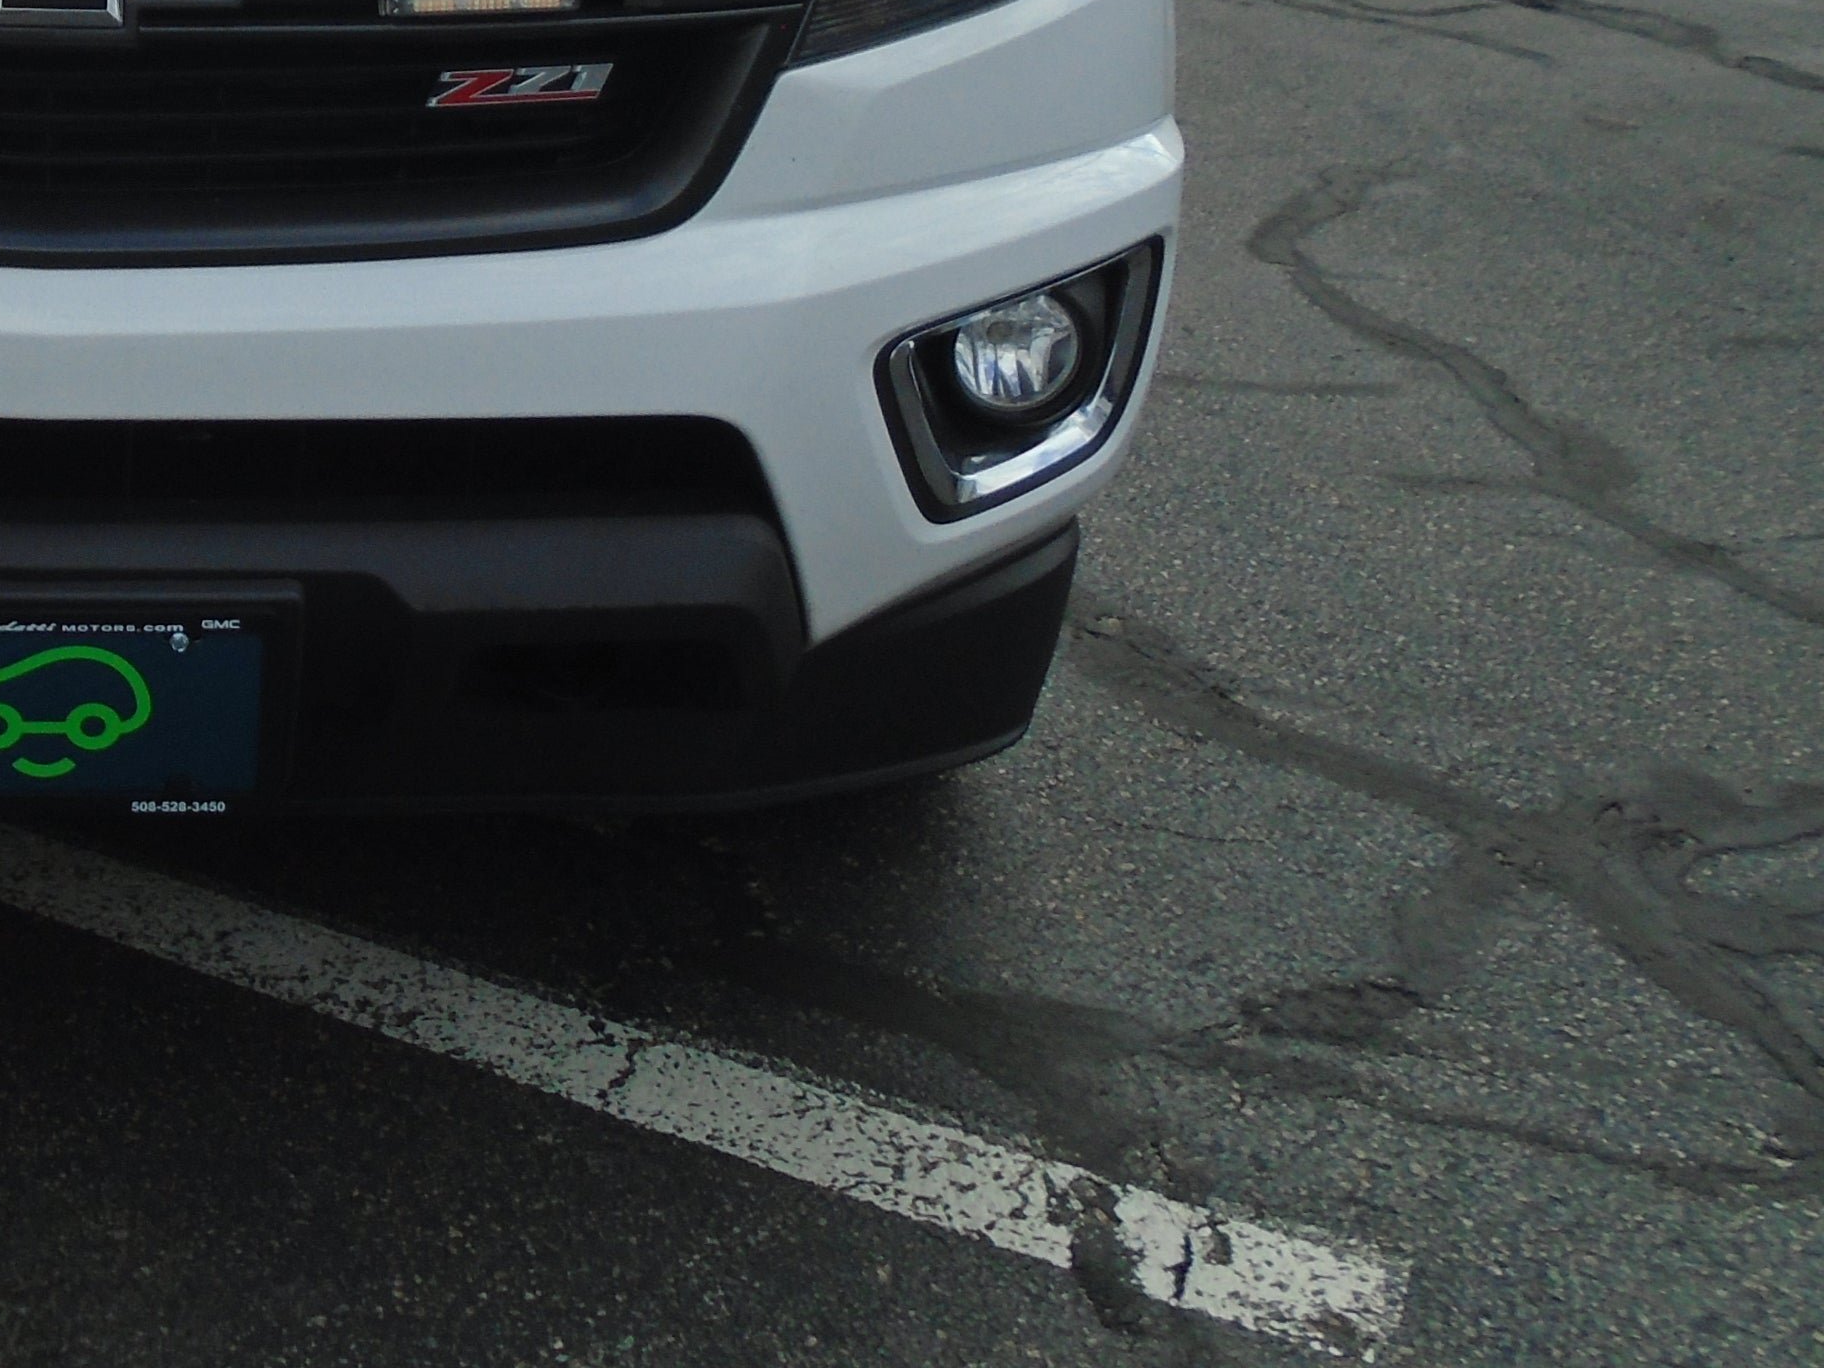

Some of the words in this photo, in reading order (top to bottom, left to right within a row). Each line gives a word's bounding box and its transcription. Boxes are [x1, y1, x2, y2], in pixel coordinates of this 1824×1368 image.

[426, 63, 614, 107] Z71
[201, 619, 241, 630] GMC
[131, 800, 226, 813] 508-528-3450
